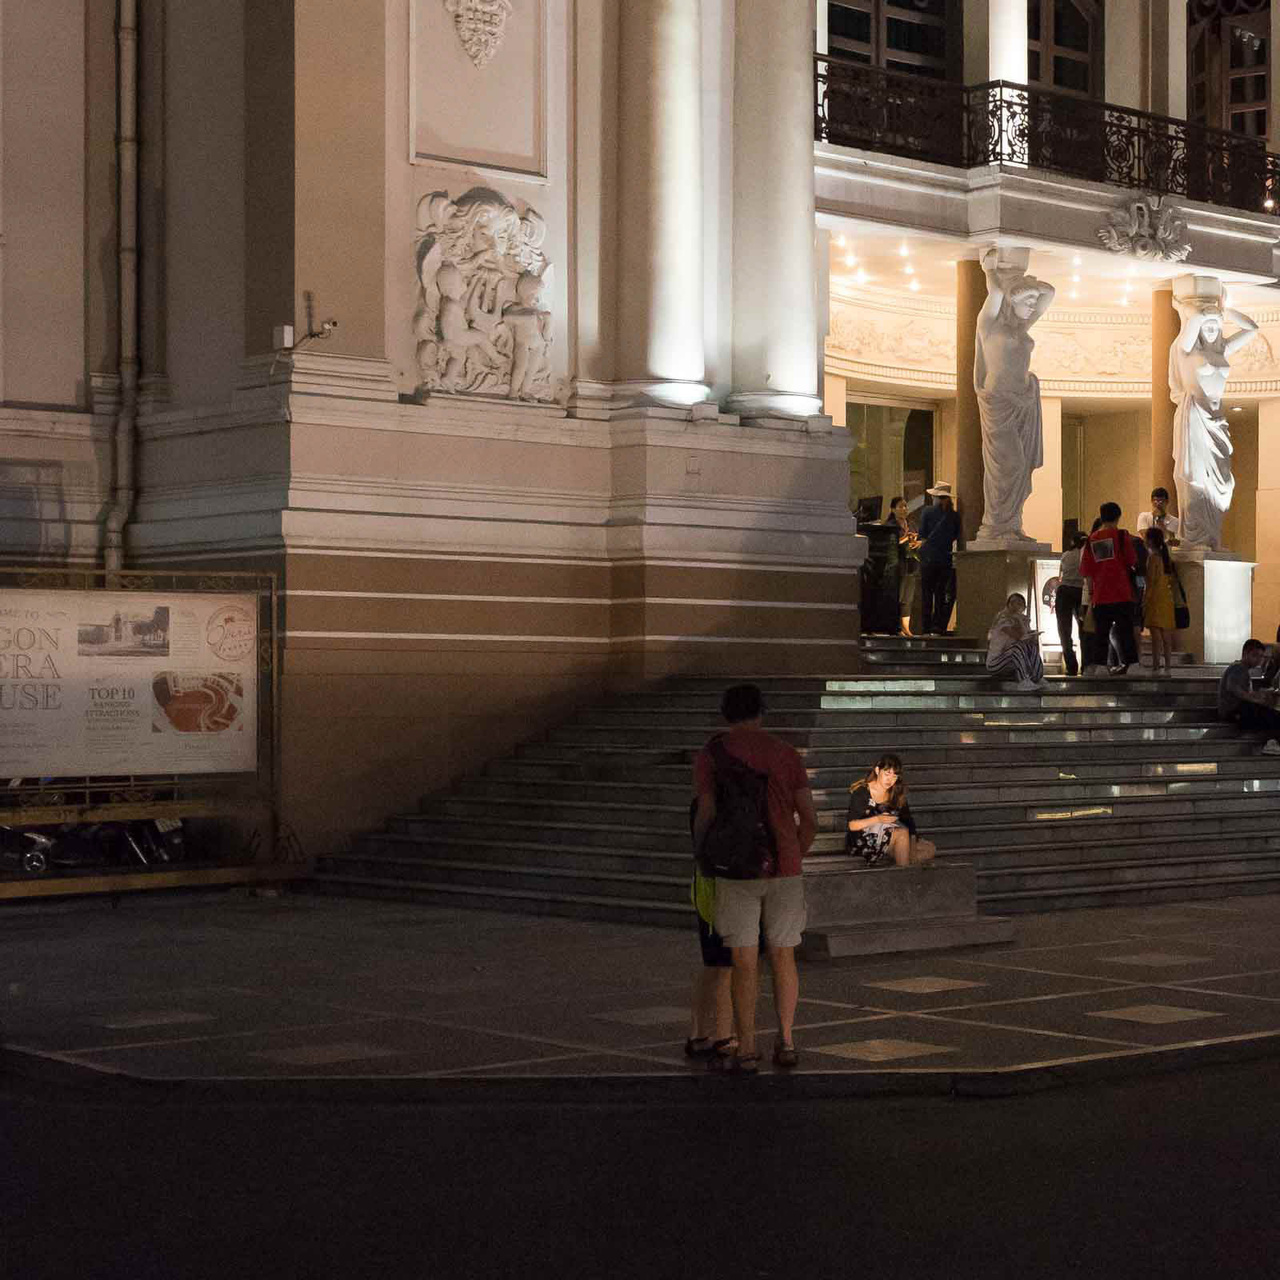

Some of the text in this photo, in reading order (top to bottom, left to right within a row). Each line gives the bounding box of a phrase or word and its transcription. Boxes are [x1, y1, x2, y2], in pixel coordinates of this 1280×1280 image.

[0, 683, 62, 710] USE
[89, 687, 135, 700] TOP 10
